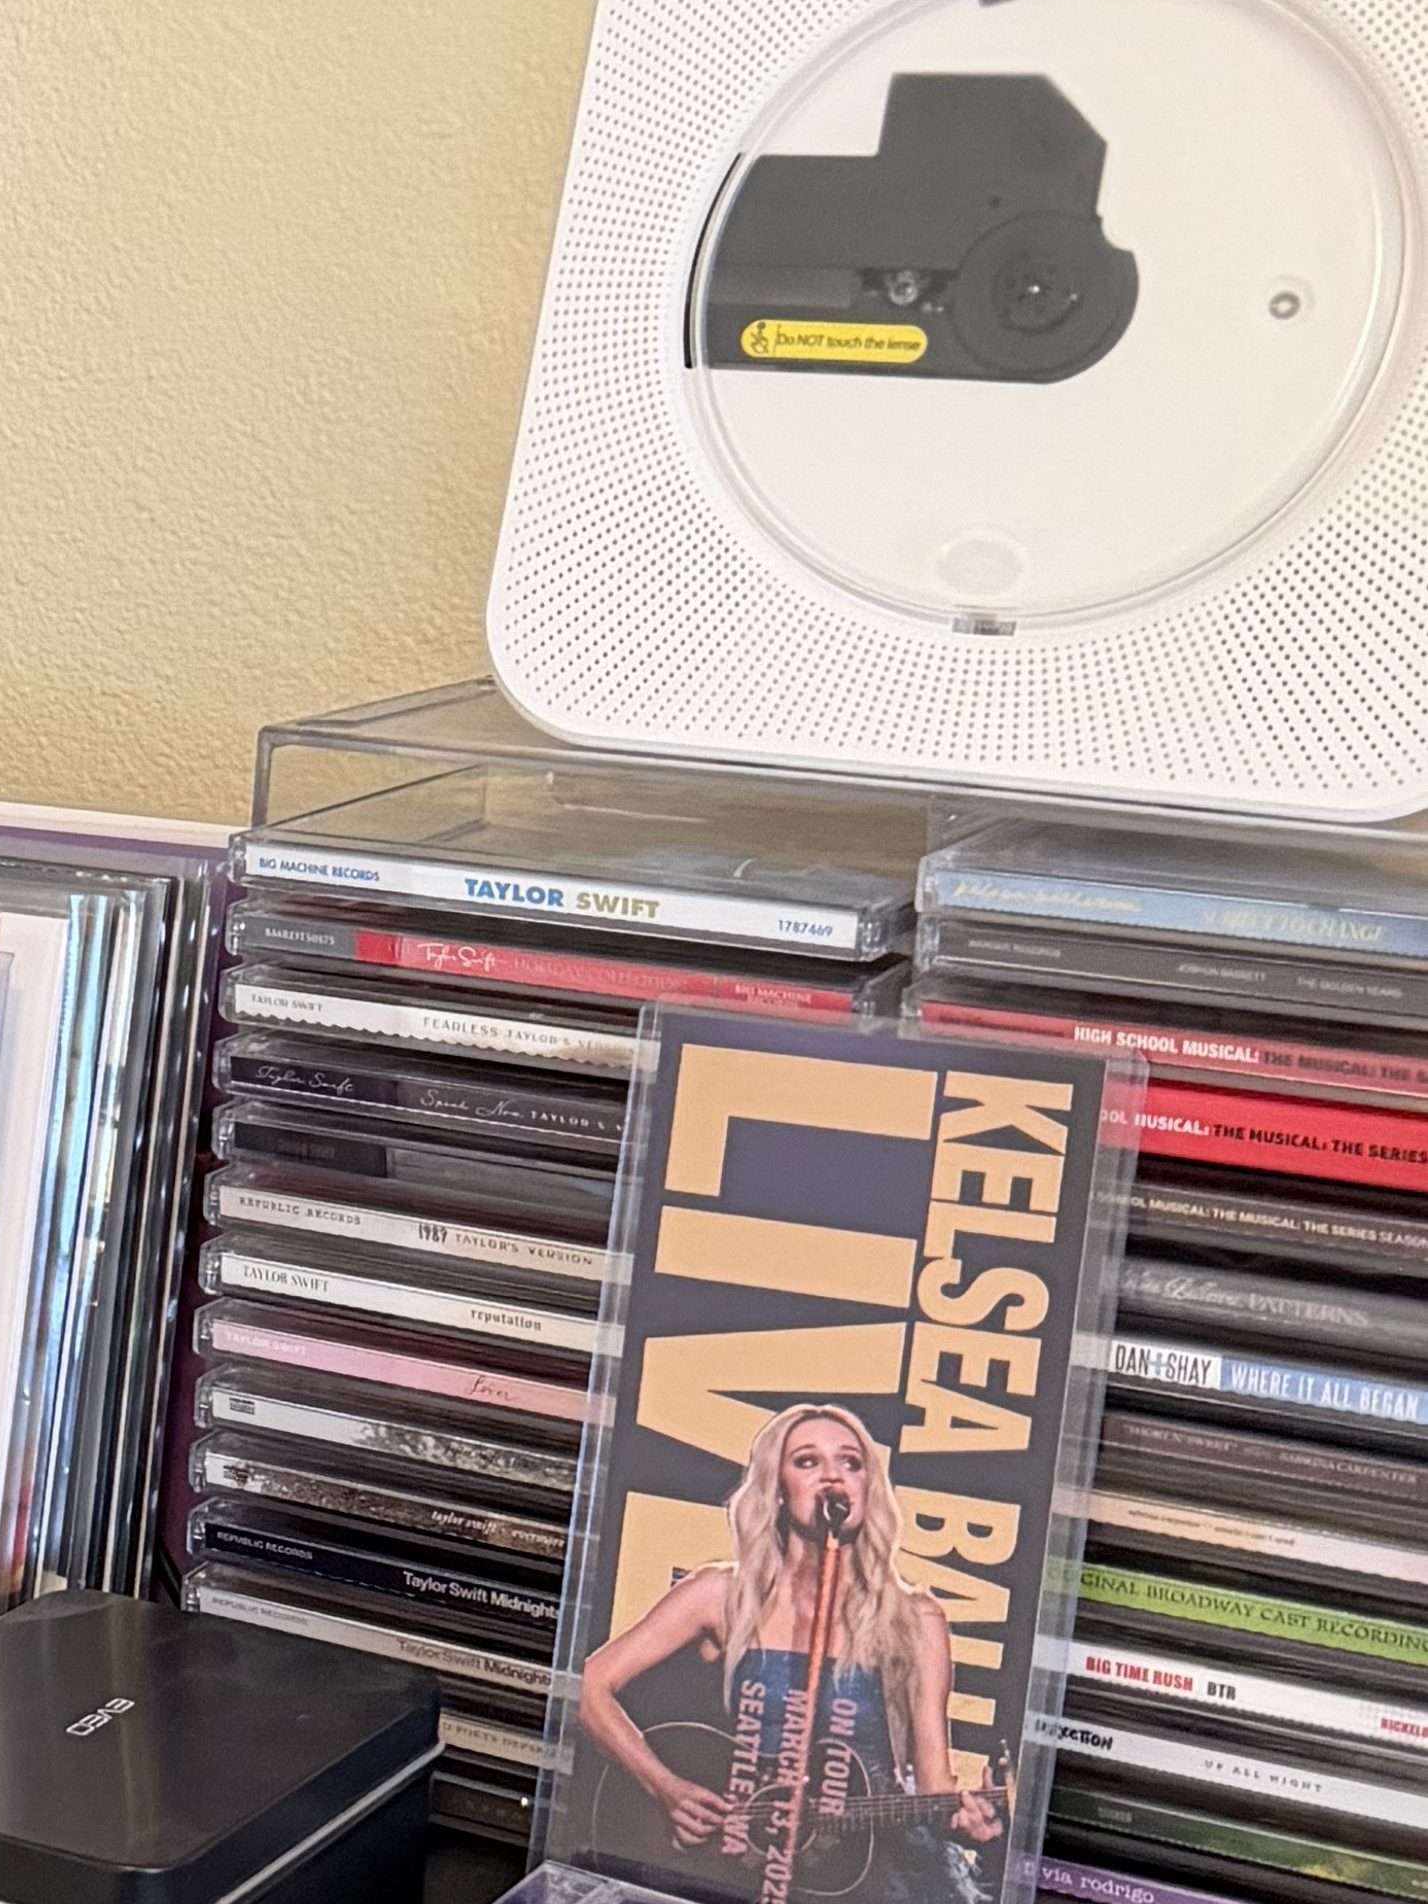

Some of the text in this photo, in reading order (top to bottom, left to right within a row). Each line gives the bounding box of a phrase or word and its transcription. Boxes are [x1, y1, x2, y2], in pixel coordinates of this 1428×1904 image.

[797, 333, 824, 346] NOT
[826, 336, 862, 349] touch
[864, 337, 886, 350] the
[259, 857, 659, 919] BIG MACHINE RECORDS TAYLOR SWIFT
[423, 1016, 497, 1037] FEARLESS
[1074, 1025, 1111, 1044] HIGH
[1116, 1030, 1178, 1052] SCHOOL
[1182, 1038, 1258, 1063] MUSICAL:
[1263, 1050, 1292, 1067] THE
[1214, 1126, 1428, 1164] THE THE SERIES
[1213, 1206, 1328, 1233] THE THE
[456, 1233, 519, 1253] TAYLOR'S
[900, 1070, 1074, 1454] KELSEA
[470, 1307, 542, 1333] reputation
[1167, 1353, 1419, 1419] SHAY WHERE IT ALL BEGAN
[403, 1570, 486, 1603] Taylor Swift
[1146, 1583, 1311, 1630] BROADWAY CAST
[399, 1638, 480, 1670] Taylor Swift
[1086, 1655, 1236, 1700] BIG TIME RUSH BTR
[731, 1680, 768, 1804] SEATTLE,
[777, 1688, 810, 1786] MARCH
[820, 1735, 852, 1818] TOUR
